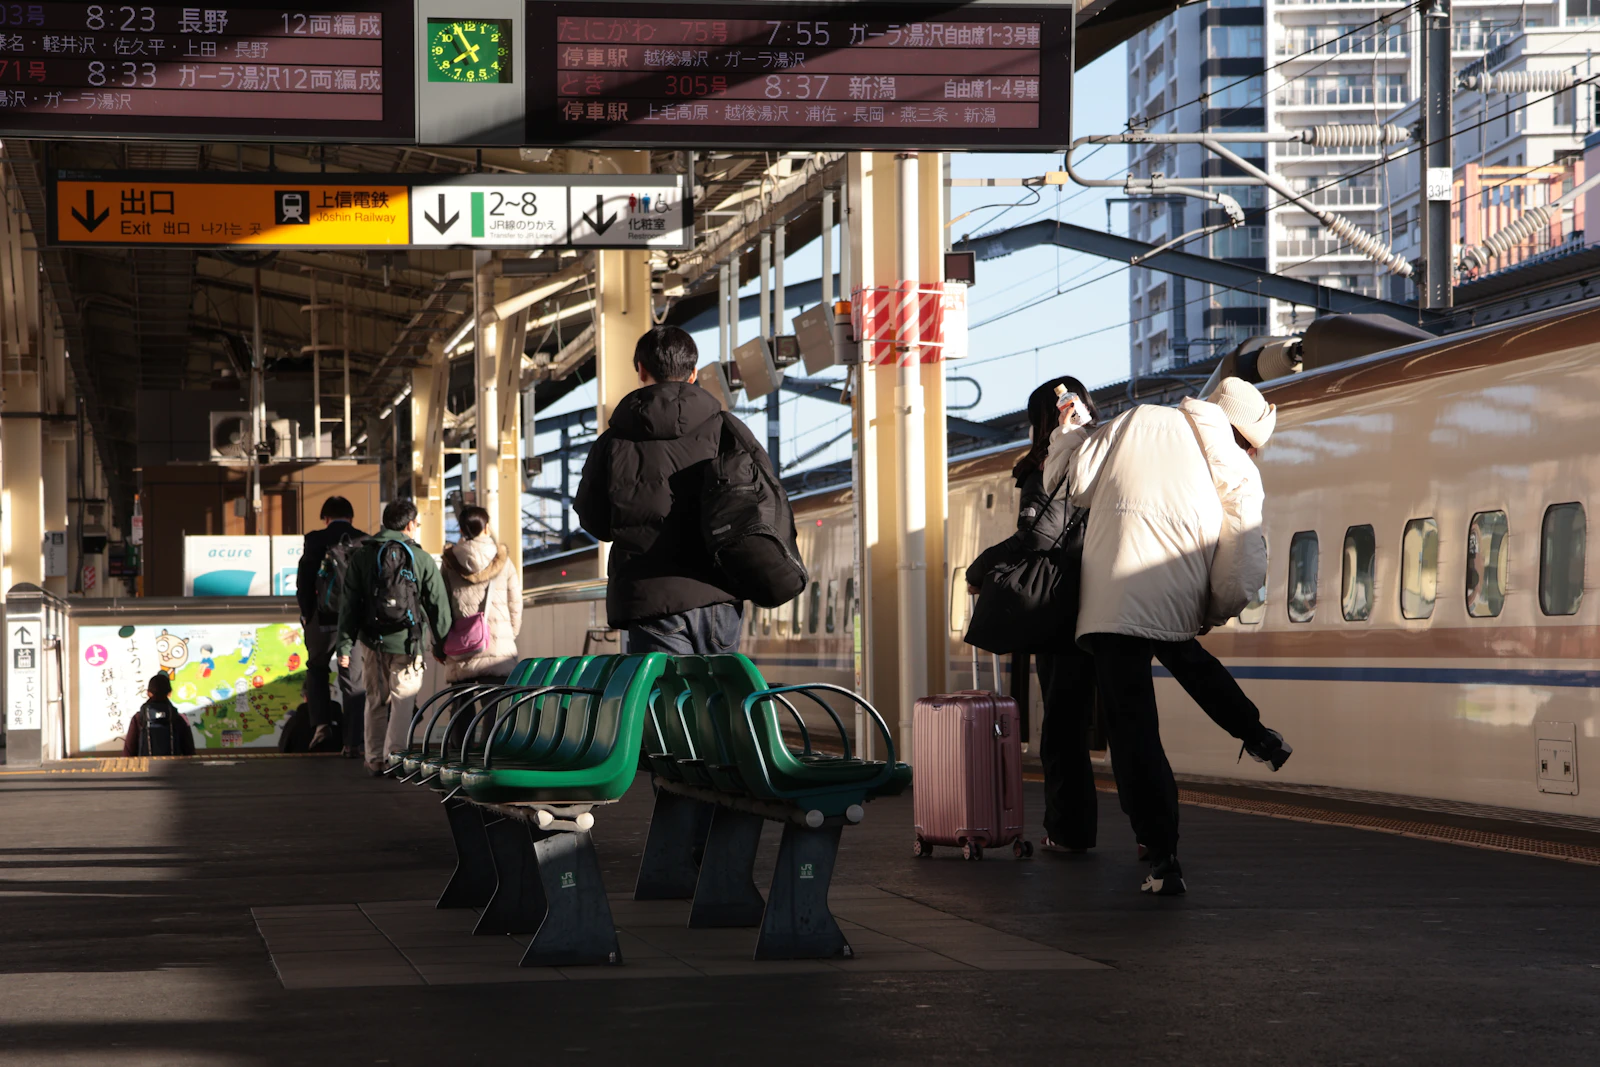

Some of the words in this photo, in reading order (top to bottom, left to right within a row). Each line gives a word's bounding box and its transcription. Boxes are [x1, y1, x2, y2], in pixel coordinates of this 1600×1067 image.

[86, 5, 156, 32] 8:23
[178, 9, 229, 34] 長野
[281, 13, 381, 36] 12両編成
[464, 23, 476, 31] 12
[480, 26, 485, 34] 1
[558, 19, 656, 43] たにがわ
[679, 21, 729, 44] 75号
[766, 21, 830, 46] 7:55
[442, 34, 453, 42] 10
[491, 34, 499, 42] 2
[435, 47, 443, 55] 9
[498, 48, 505, 56] 3
[562, 47, 628, 68] 停車駅
[442, 60, 450, 69] 8
[491, 61, 499, 69] 4
[88, 61, 157, 87] 8:33
[454, 68, 462, 77] 7
[466, 71, 474, 79] 6
[479, 68, 487, 77] 5
[560, 74, 606, 96] とき
[664, 76, 728, 96] 305号
[764, 75, 830, 100] 8:37
[848, 76, 897, 101] 新潟
[562, 101, 629, 122] 停車駅
[120, 188, 175, 215] 出口
[316, 191, 389, 209] 上信電鉄
[354, 211, 396, 224] Railway
[121, 220, 151, 235] Exit
[163, 221, 190, 235] 出口
[201, 222, 242, 235] 나가는
[249, 223, 262, 235] 곳
[490, 220, 557, 231] JR線のりかえ
[628, 218, 666, 231] 化粧室
[208, 549, 252, 558] acure
[87, 645, 105, 664] よ
